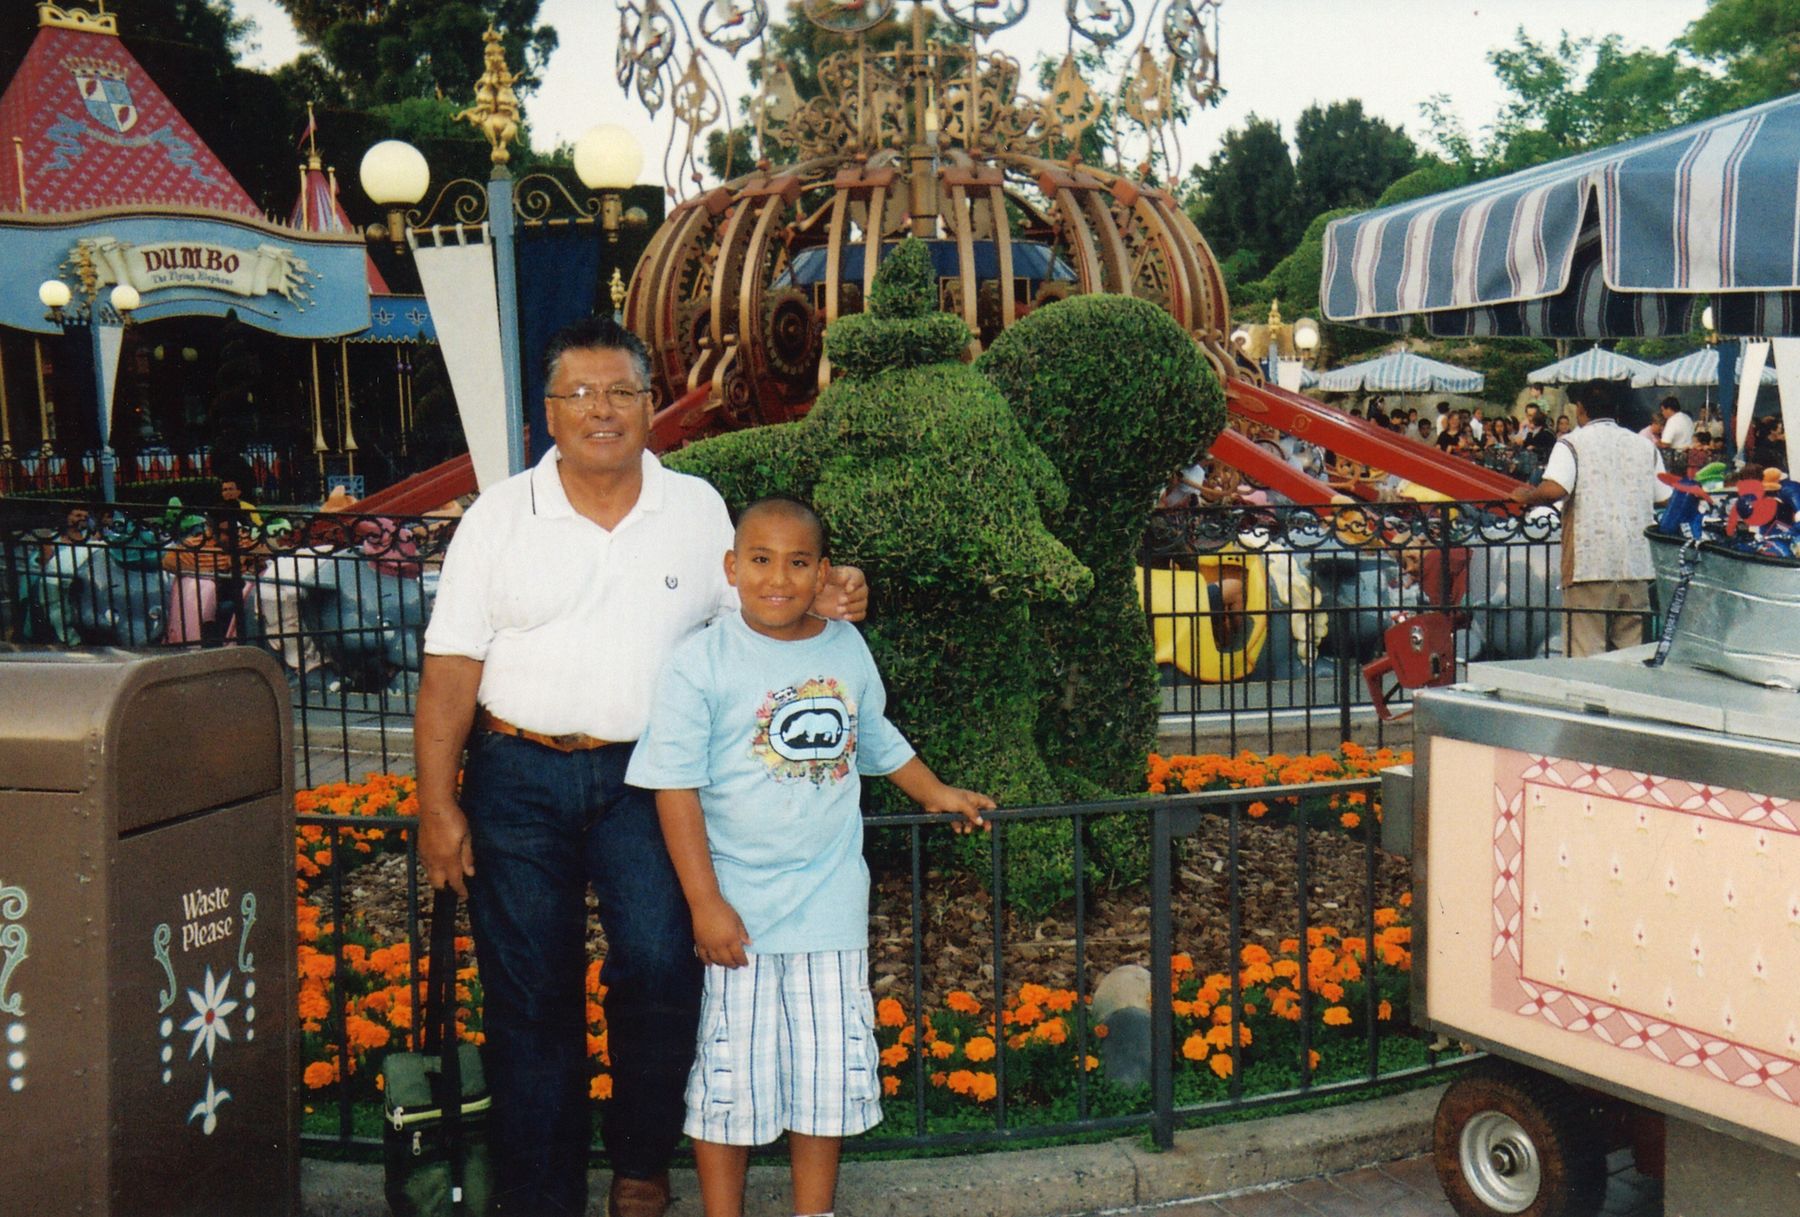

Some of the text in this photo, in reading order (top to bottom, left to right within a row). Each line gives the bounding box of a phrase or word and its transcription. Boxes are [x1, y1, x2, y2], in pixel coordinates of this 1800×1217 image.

[142, 247, 239, 273] DUMBO
[152, 270, 234, 285] The Flying Elephant
[182, 887, 230, 920] Waste
[182, 917, 233, 952] Please
